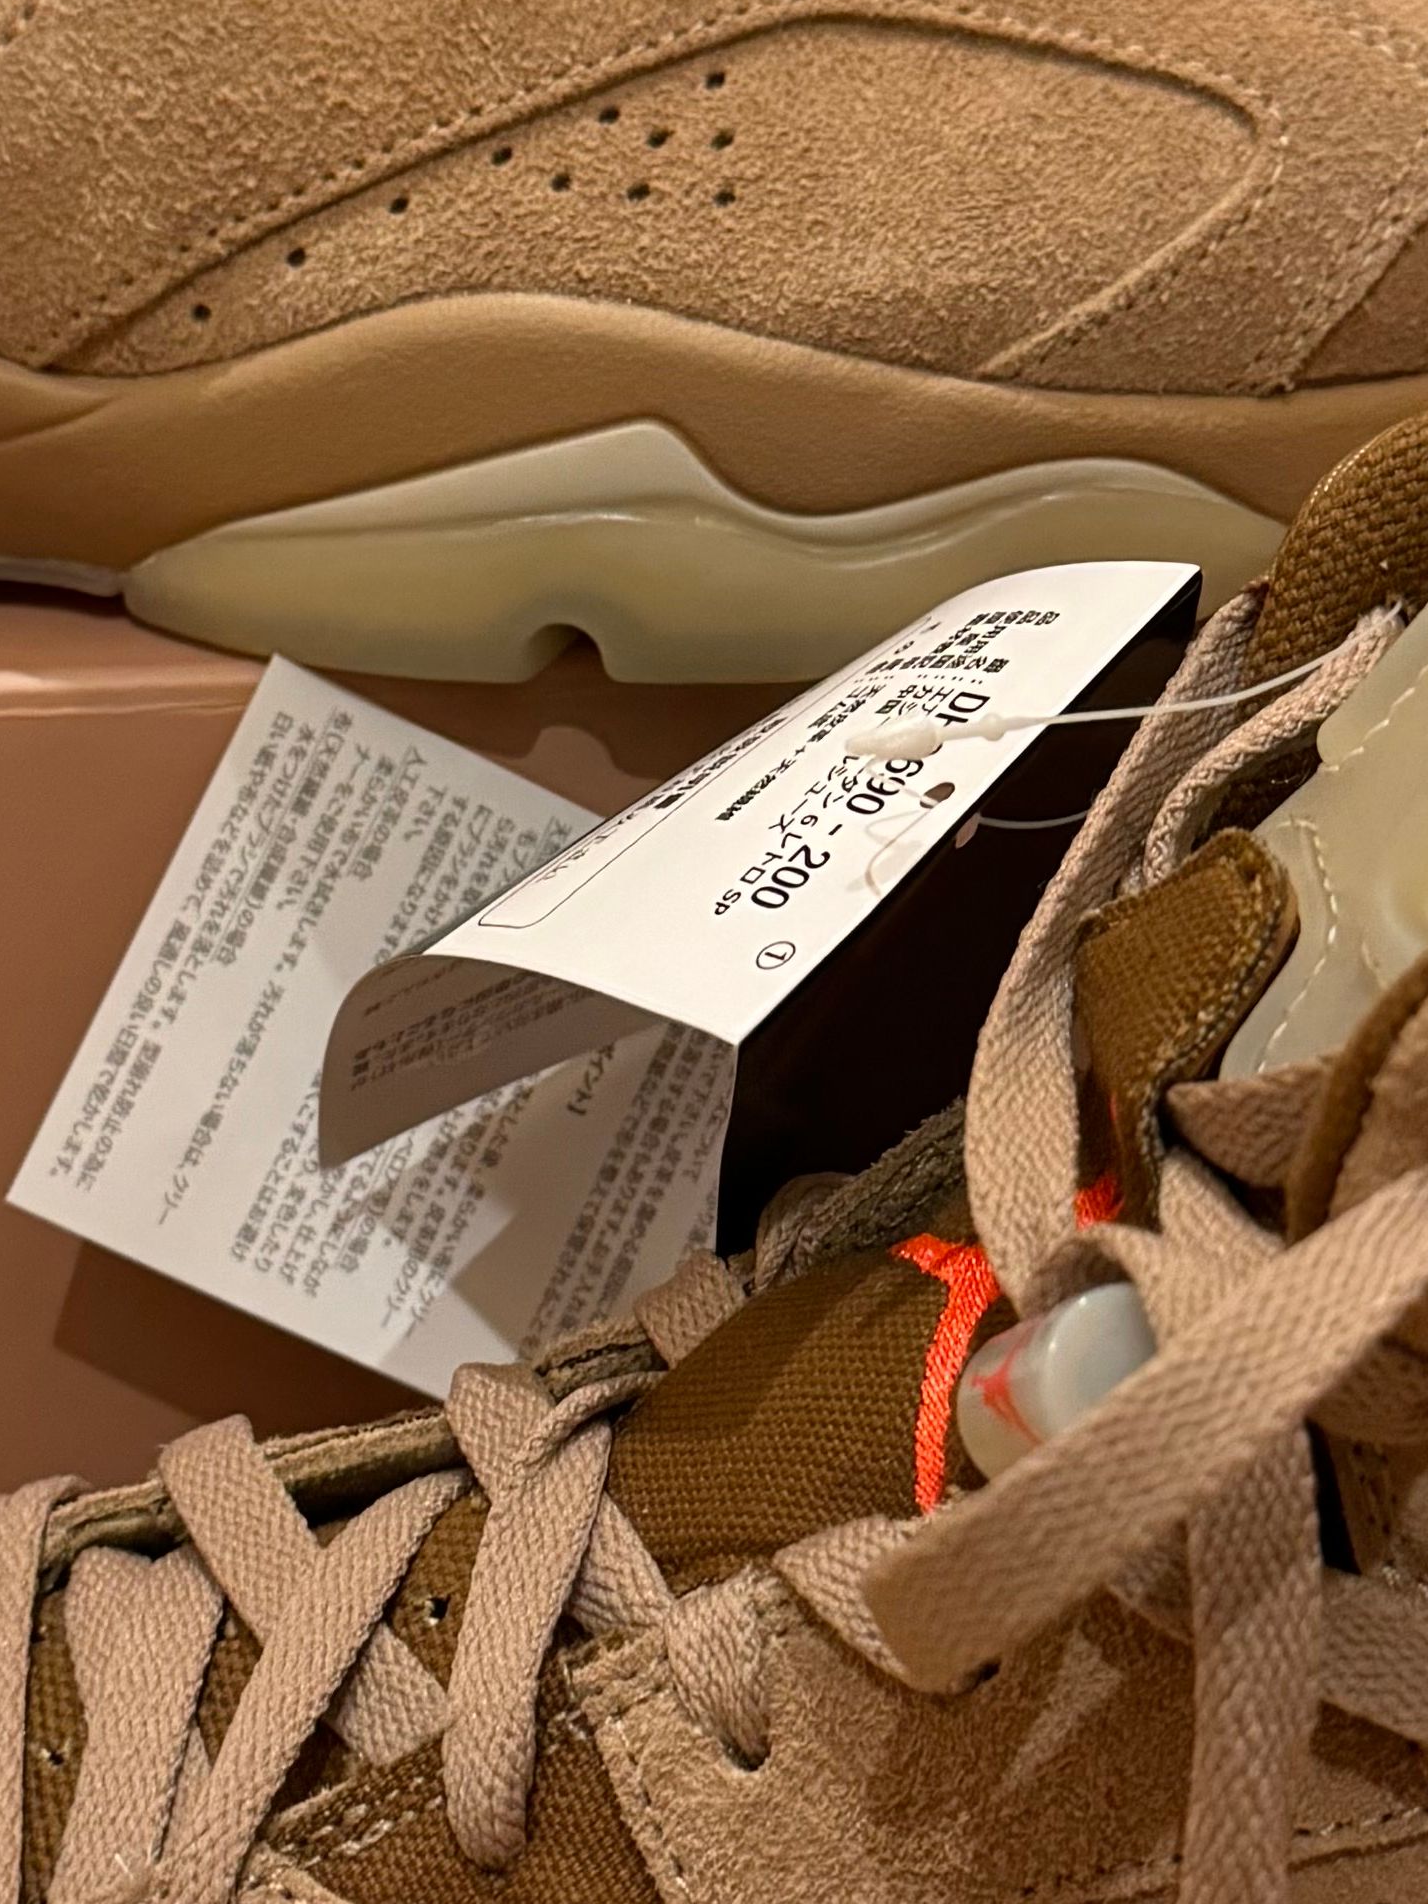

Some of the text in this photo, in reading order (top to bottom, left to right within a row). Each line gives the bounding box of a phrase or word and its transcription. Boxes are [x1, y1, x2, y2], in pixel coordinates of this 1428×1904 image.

[872, 684, 919, 714] 中国
[837, 691, 990, 815] DH690
[273, 742, 374, 918] ナーをご使用下さい。
[348, 746, 431, 884] 人工皮革の場合
[399, 780, 447, 849] 下さい。
[797, 813, 824, 826] 6
[493, 827, 541, 895] 毛ブラ
[737, 832, 802, 885] レトロ
[742, 844, 833, 911] 200
[709, 888, 743, 917] SP
[391, 1066, 543, 1340] 落とした後、柔らかい布にクリー
